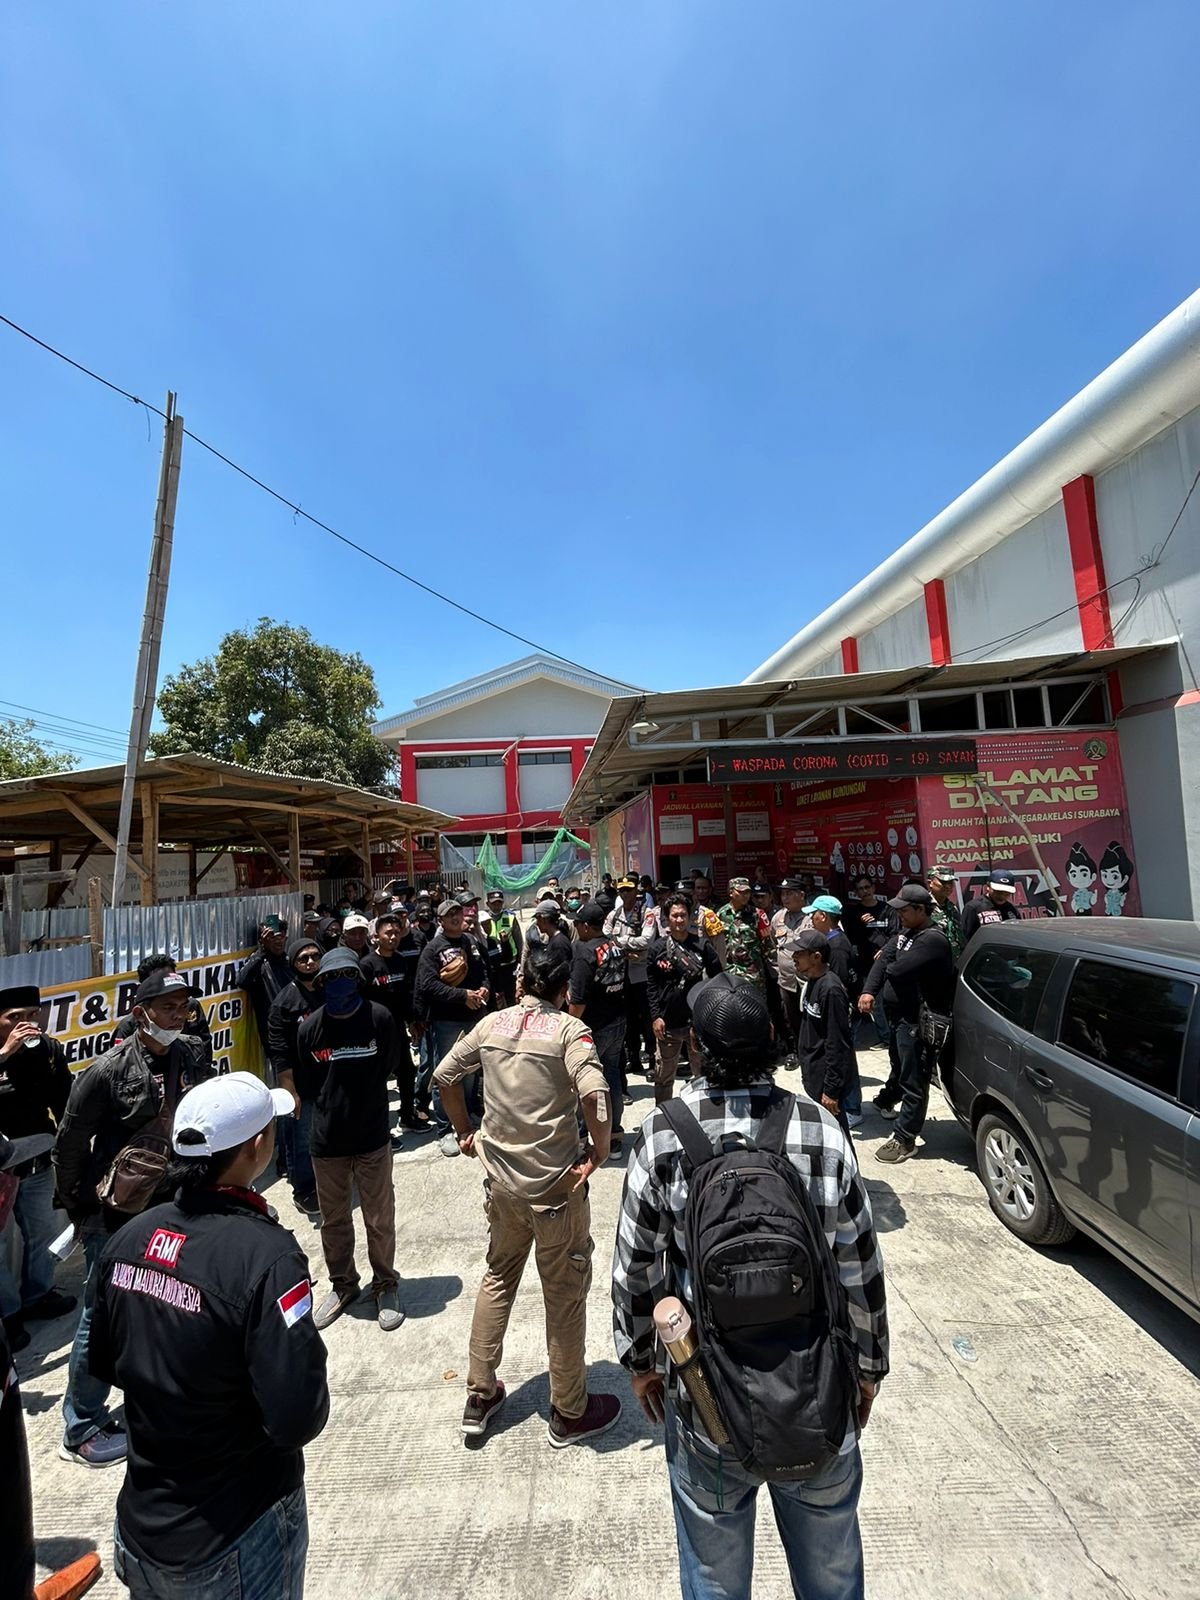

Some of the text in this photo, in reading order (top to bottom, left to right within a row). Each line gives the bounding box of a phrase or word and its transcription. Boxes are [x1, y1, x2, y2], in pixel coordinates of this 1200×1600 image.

[732, 758, 786, 772] WASPADA
[792, 755, 838, 770] CORONA
[847, 753, 889, 768] (COVID
[943, 766, 1099, 789] SELAMAT
[661, 803, 690, 812] JADWAL
[691, 801, 724, 810] LAYANAN
[949, 785, 1099, 809] DATANG
[932, 819, 941, 828] DI
[942, 817, 973, 827] RUMAH
[1077, 808, 1121, 818] SURABAYA
[935, 833, 1062, 850] ANDA MEMASUKI
[936, 849, 1015, 864] KAWASAN
[82, 994, 108, 1026] &
[208, 998, 241, 1027] / CB
[148, 1233, 182, 1263] AMI
[160, 1275, 201, 1313] INDONESIA
